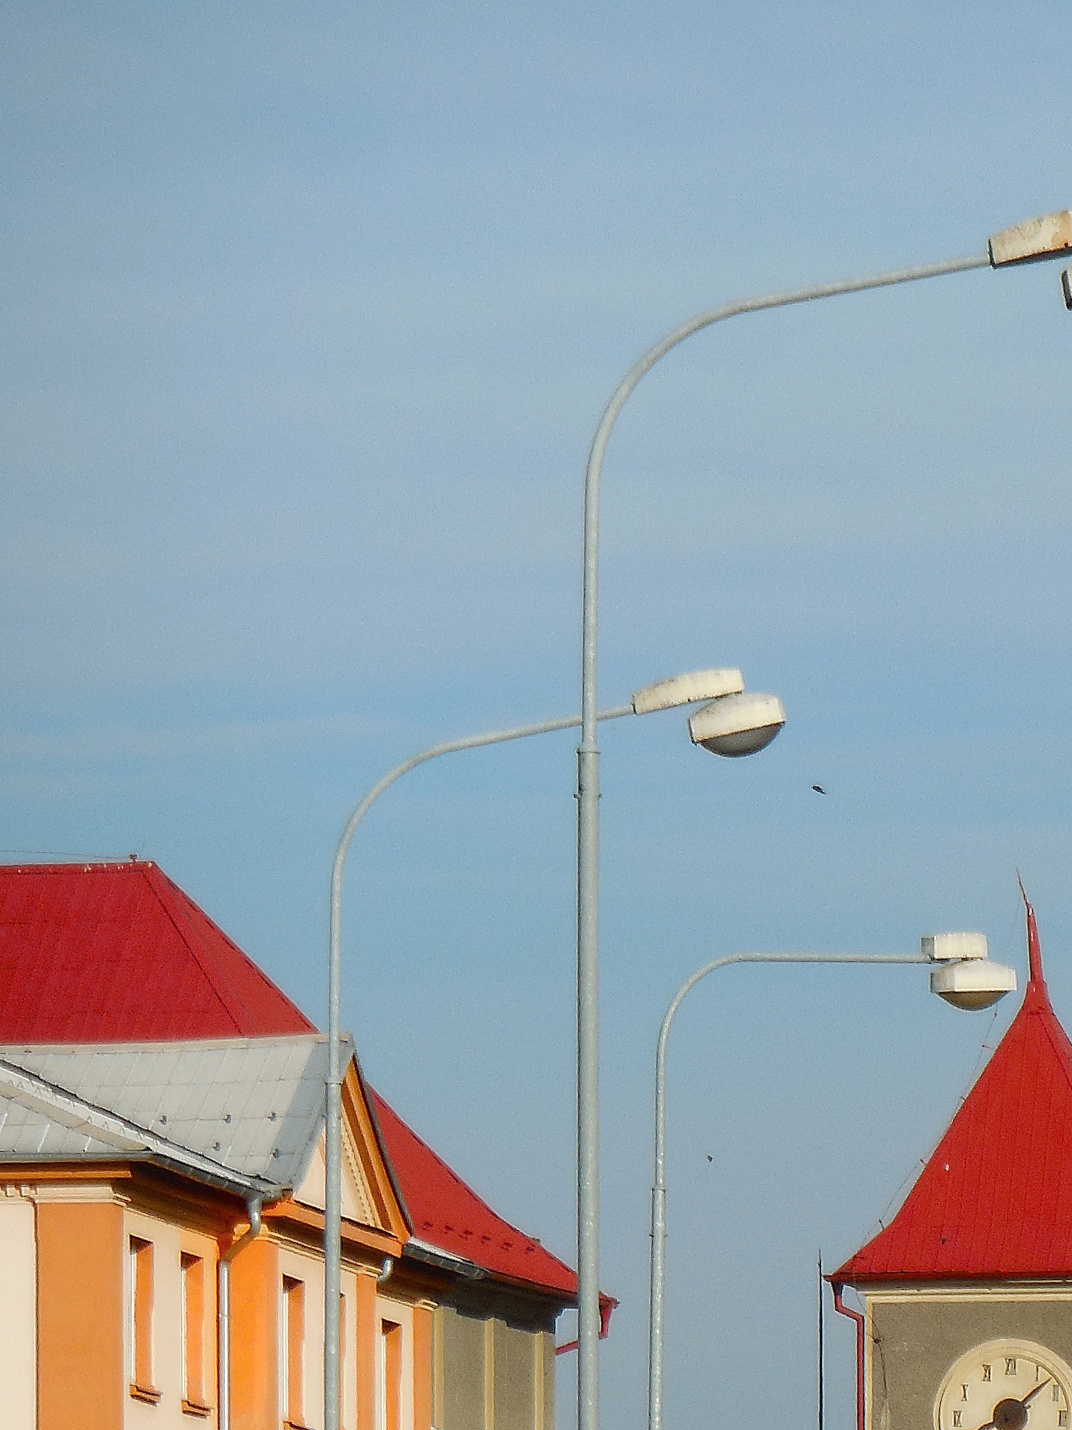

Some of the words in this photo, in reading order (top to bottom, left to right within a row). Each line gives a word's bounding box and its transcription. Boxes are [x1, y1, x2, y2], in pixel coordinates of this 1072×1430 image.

[1004, 1357, 1017, 1375] XII
[960, 1384, 969, 1401] X
[1053, 1384, 1060, 1402] II
